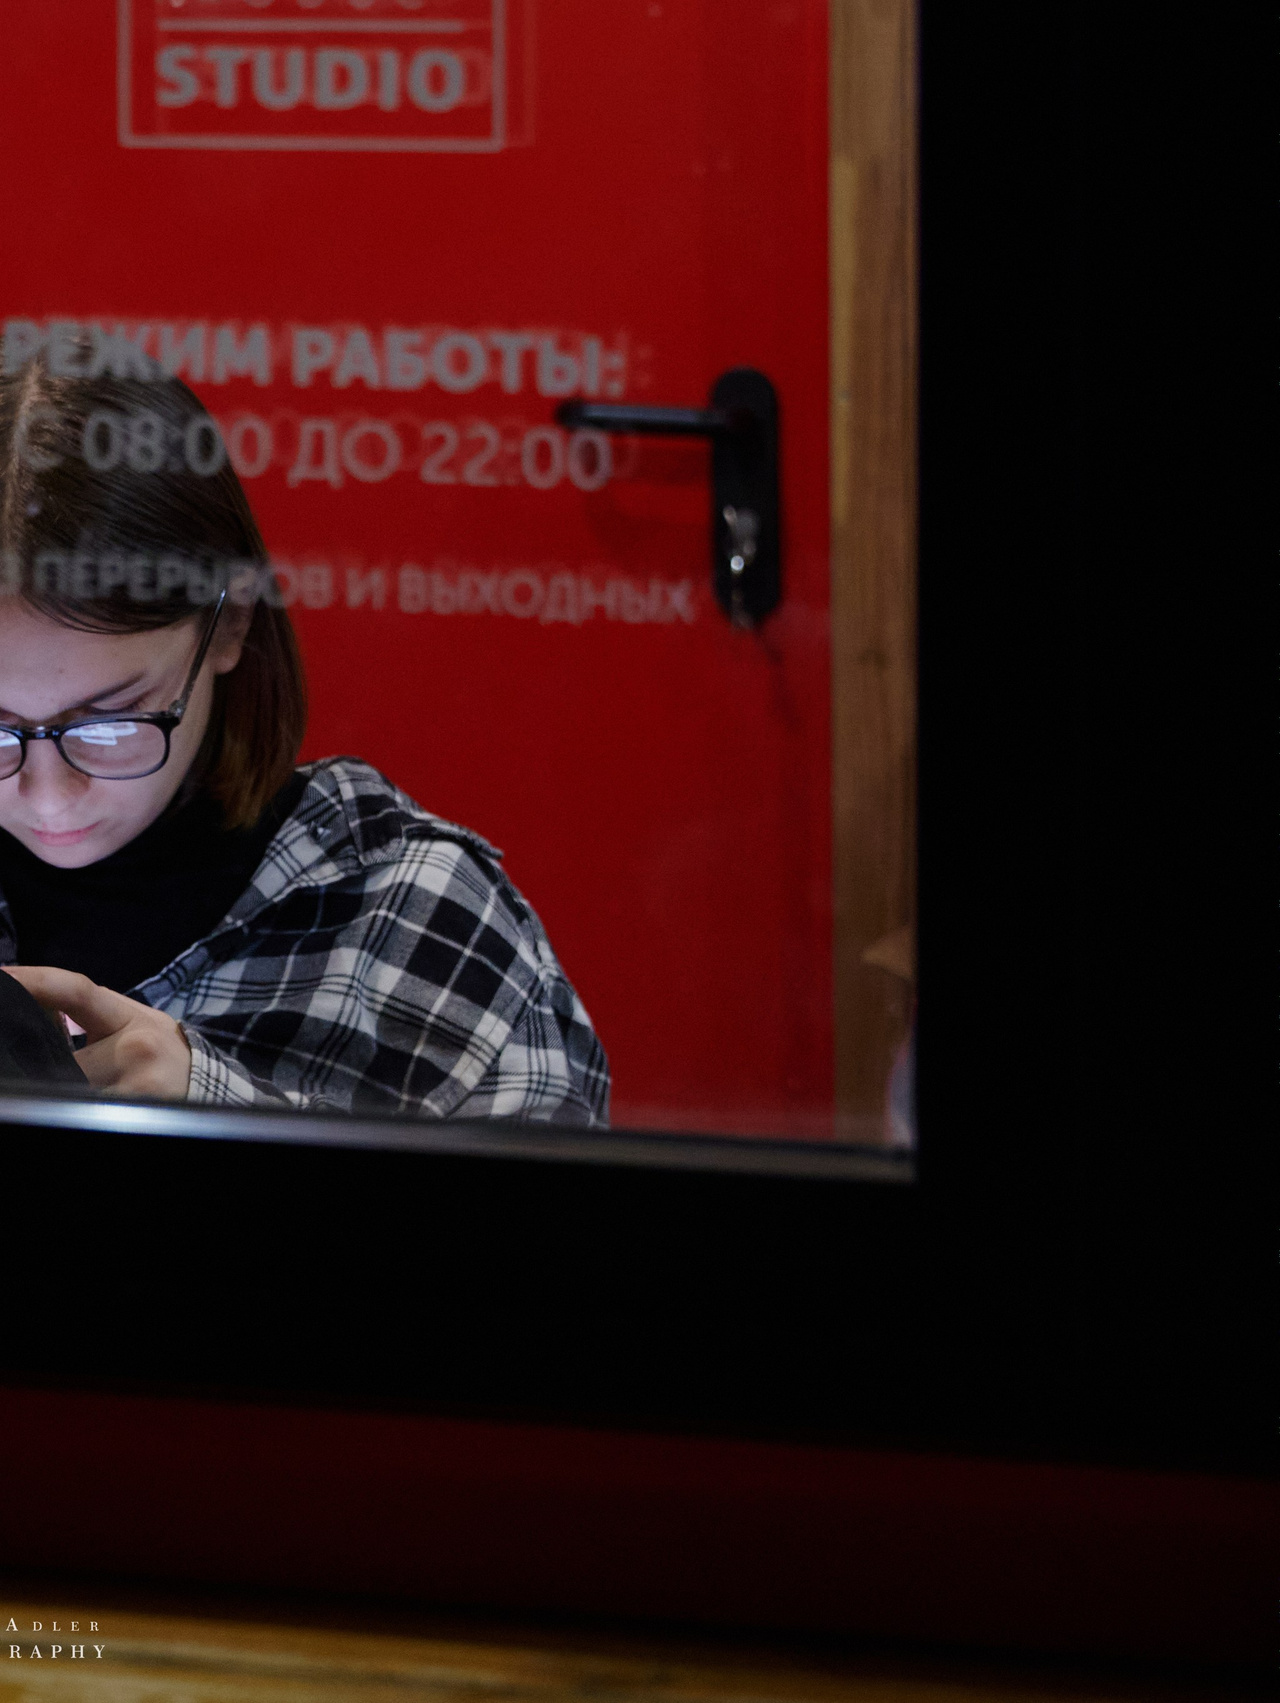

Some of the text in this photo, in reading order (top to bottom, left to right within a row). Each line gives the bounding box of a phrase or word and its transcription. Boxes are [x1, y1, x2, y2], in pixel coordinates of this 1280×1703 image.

[154, 43, 466, 113] STUDIO
[2, 317, 626, 398] РЕЖИМ РАБОТЫ:
[83, 408, 273, 478] 08:00
[286, 417, 404, 490] ДО
[420, 421, 614, 492] 22:00
[345, 564, 387, 611] И
[398, 562, 697, 627] ВЫХОДНЫХ
